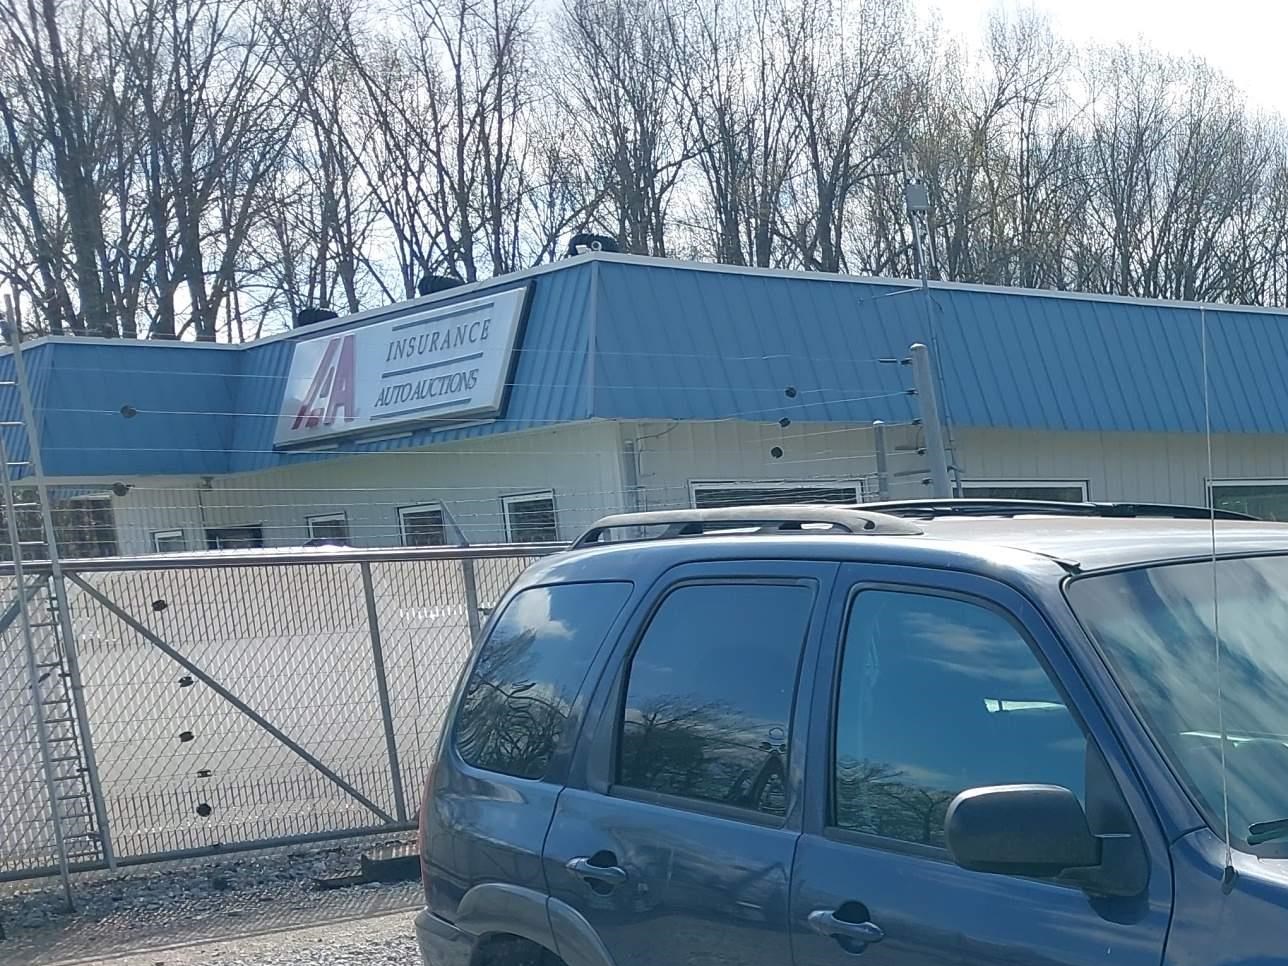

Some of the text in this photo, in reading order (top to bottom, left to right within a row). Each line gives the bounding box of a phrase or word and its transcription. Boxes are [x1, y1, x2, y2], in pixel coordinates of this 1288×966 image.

[387, 319, 491, 361] INSURANCE
[375, 369, 479, 407] AUTO AUCTIONS
